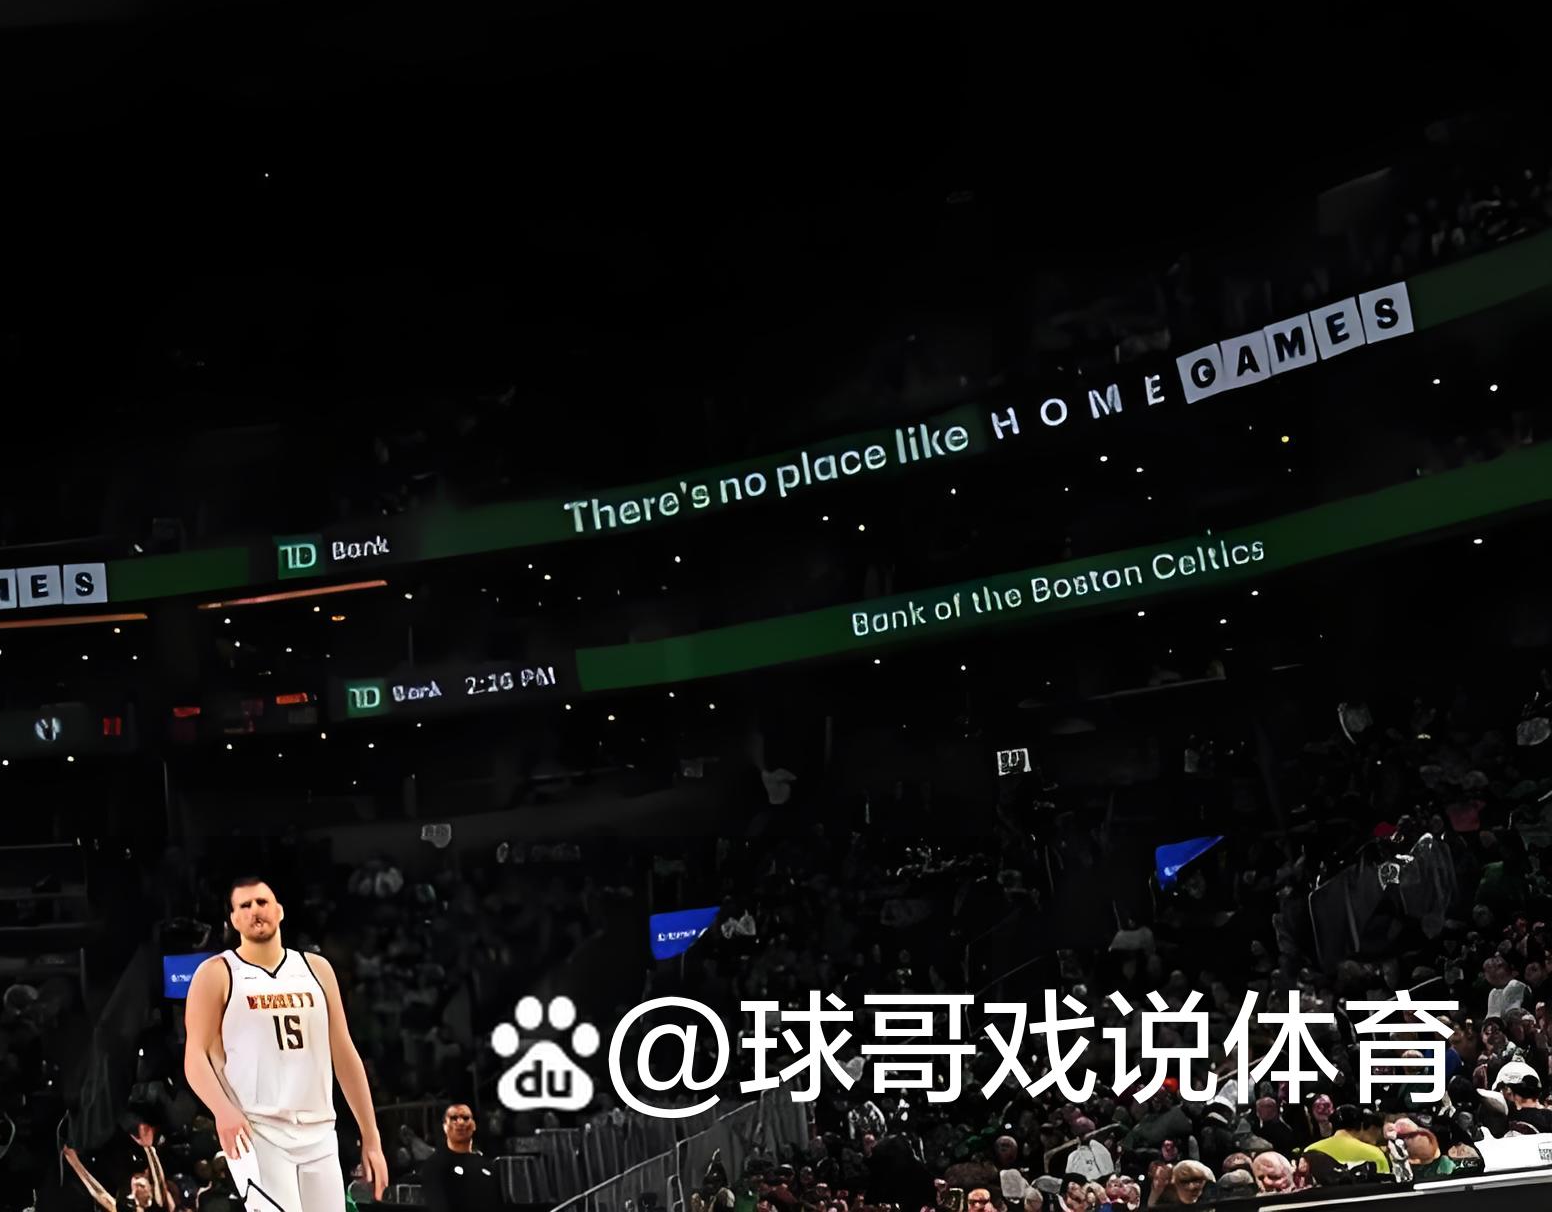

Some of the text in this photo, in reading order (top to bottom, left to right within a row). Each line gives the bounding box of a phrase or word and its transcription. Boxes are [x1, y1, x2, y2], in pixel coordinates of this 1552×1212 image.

[563, 297, 1399, 533] There's no place like HOME GAMES
[279, 543, 317, 569] TD
[852, 540, 1266, 637] Bank of the Boston Celtics
[273, 1015, 304, 1051] 15
